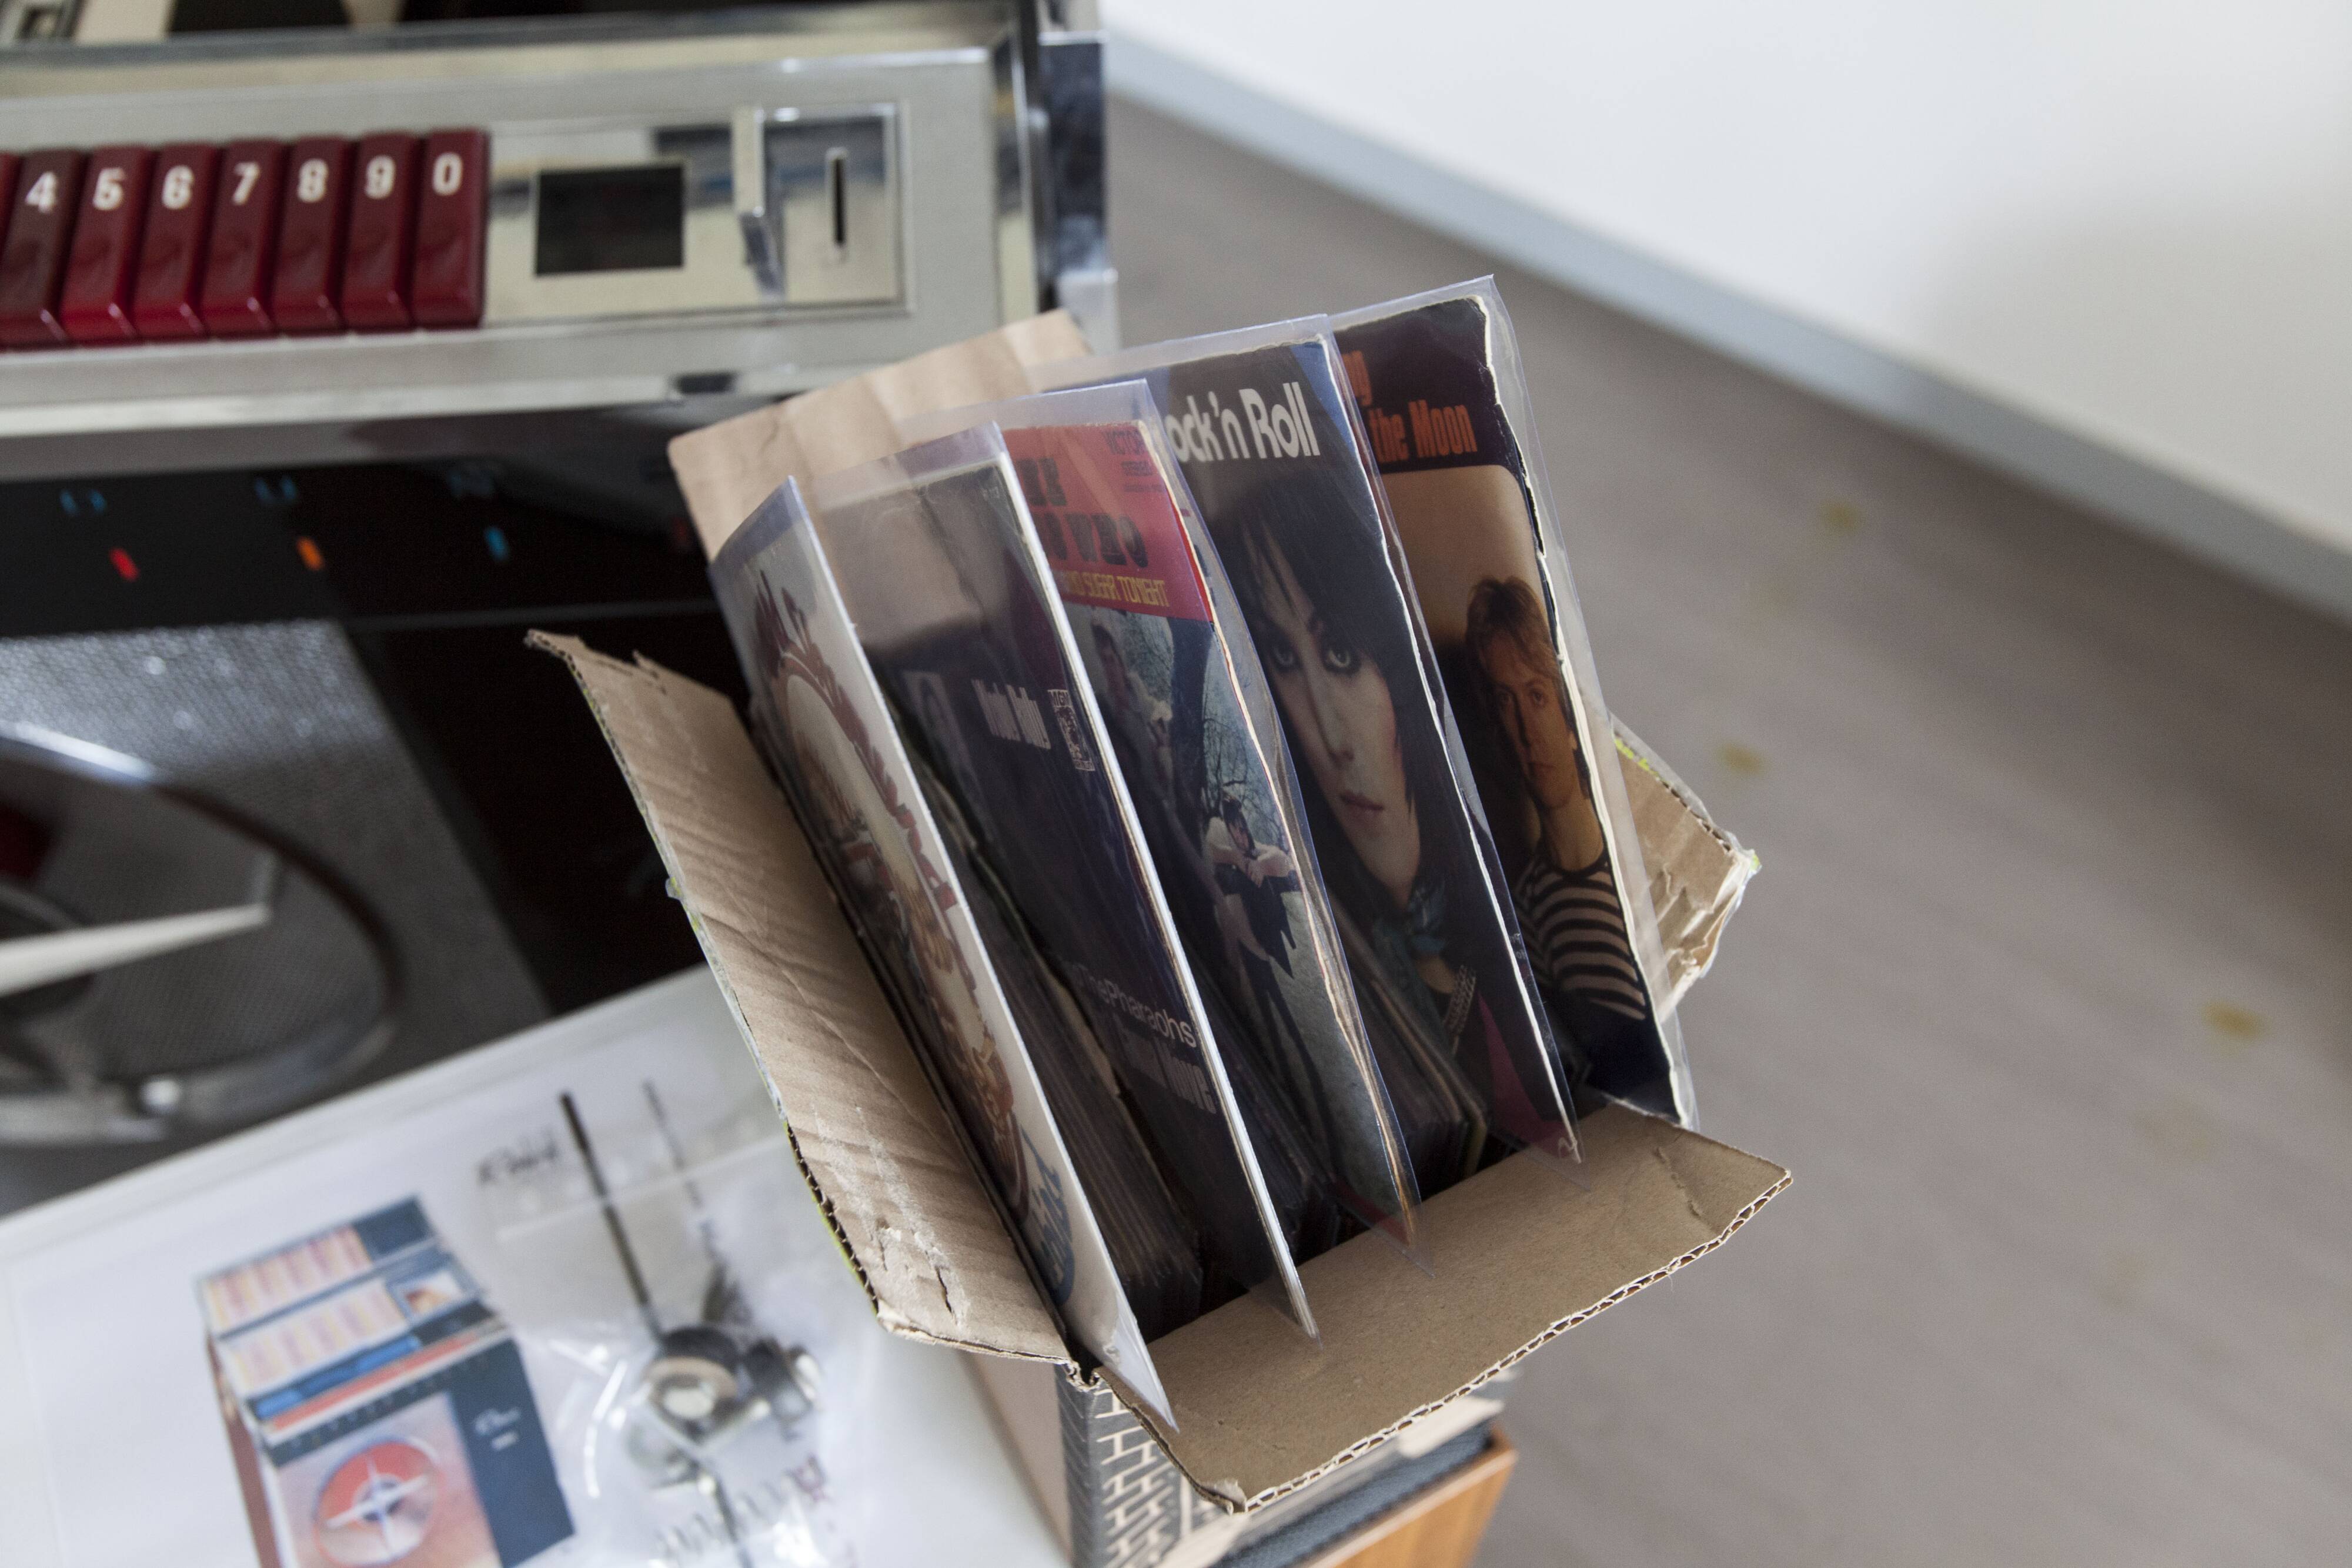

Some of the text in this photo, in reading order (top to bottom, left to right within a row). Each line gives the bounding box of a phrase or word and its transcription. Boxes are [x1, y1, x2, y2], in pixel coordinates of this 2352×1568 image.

[25, 152, 463, 213] 4 5 6 7 8 9 0
[1164, 382, 1321, 462] ock'n Roll
[1368, 399, 1478, 463] the Moon
[1117, 576, 1170, 607] TONIGHT
[1104, 978, 1197, 1049] Pharaohs
